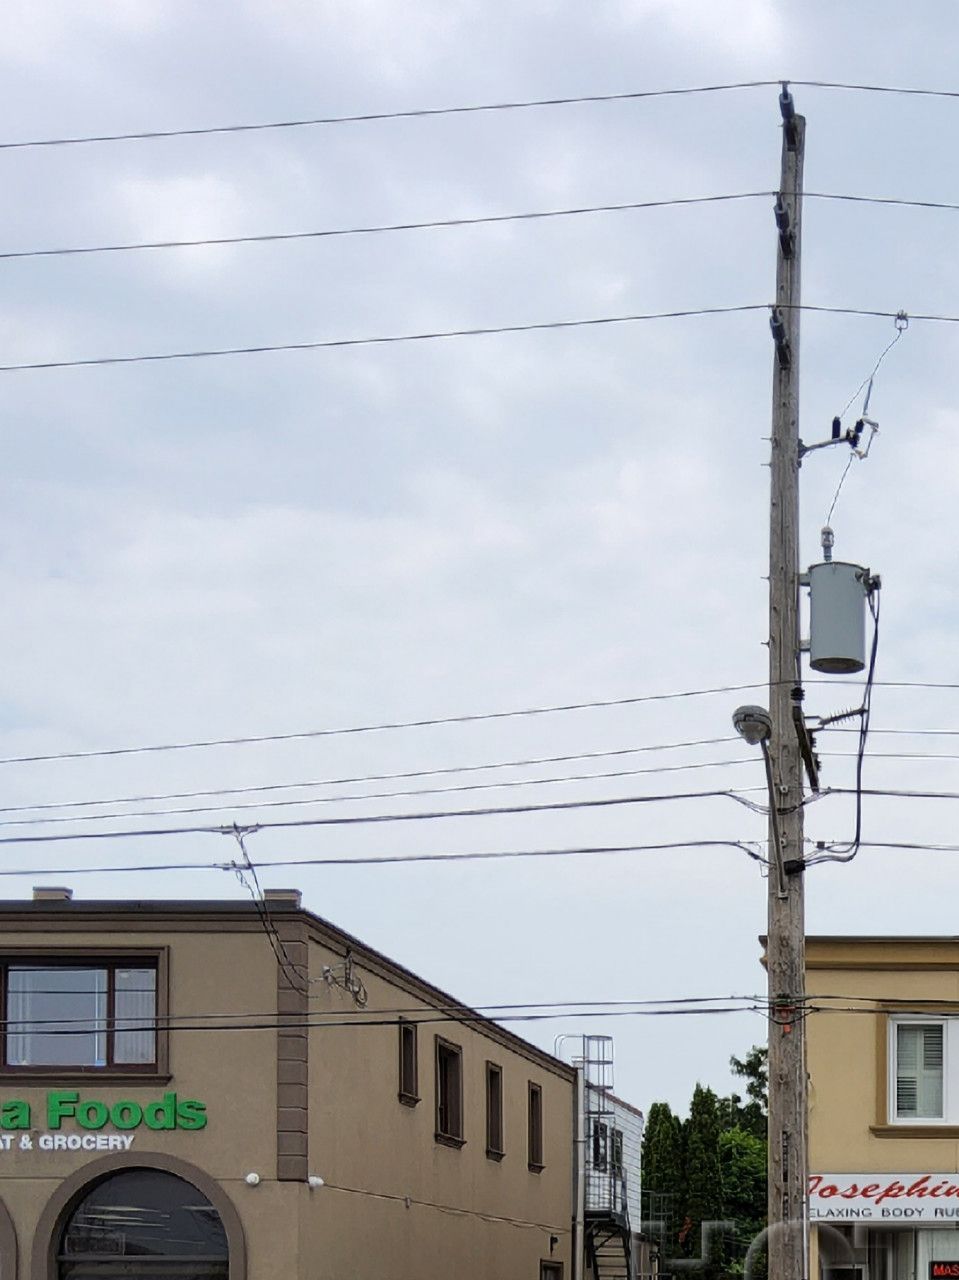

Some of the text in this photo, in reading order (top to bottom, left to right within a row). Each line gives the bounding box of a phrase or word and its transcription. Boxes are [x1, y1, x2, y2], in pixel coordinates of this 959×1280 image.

[47, 1092, 207, 1129] Foods
[19, 1134, 33, 1150] &
[39, 1134, 134, 1150] GROCERY
[809, 1208, 872, 1218] ELAXING
[882, 1208, 924, 1218] BODY
